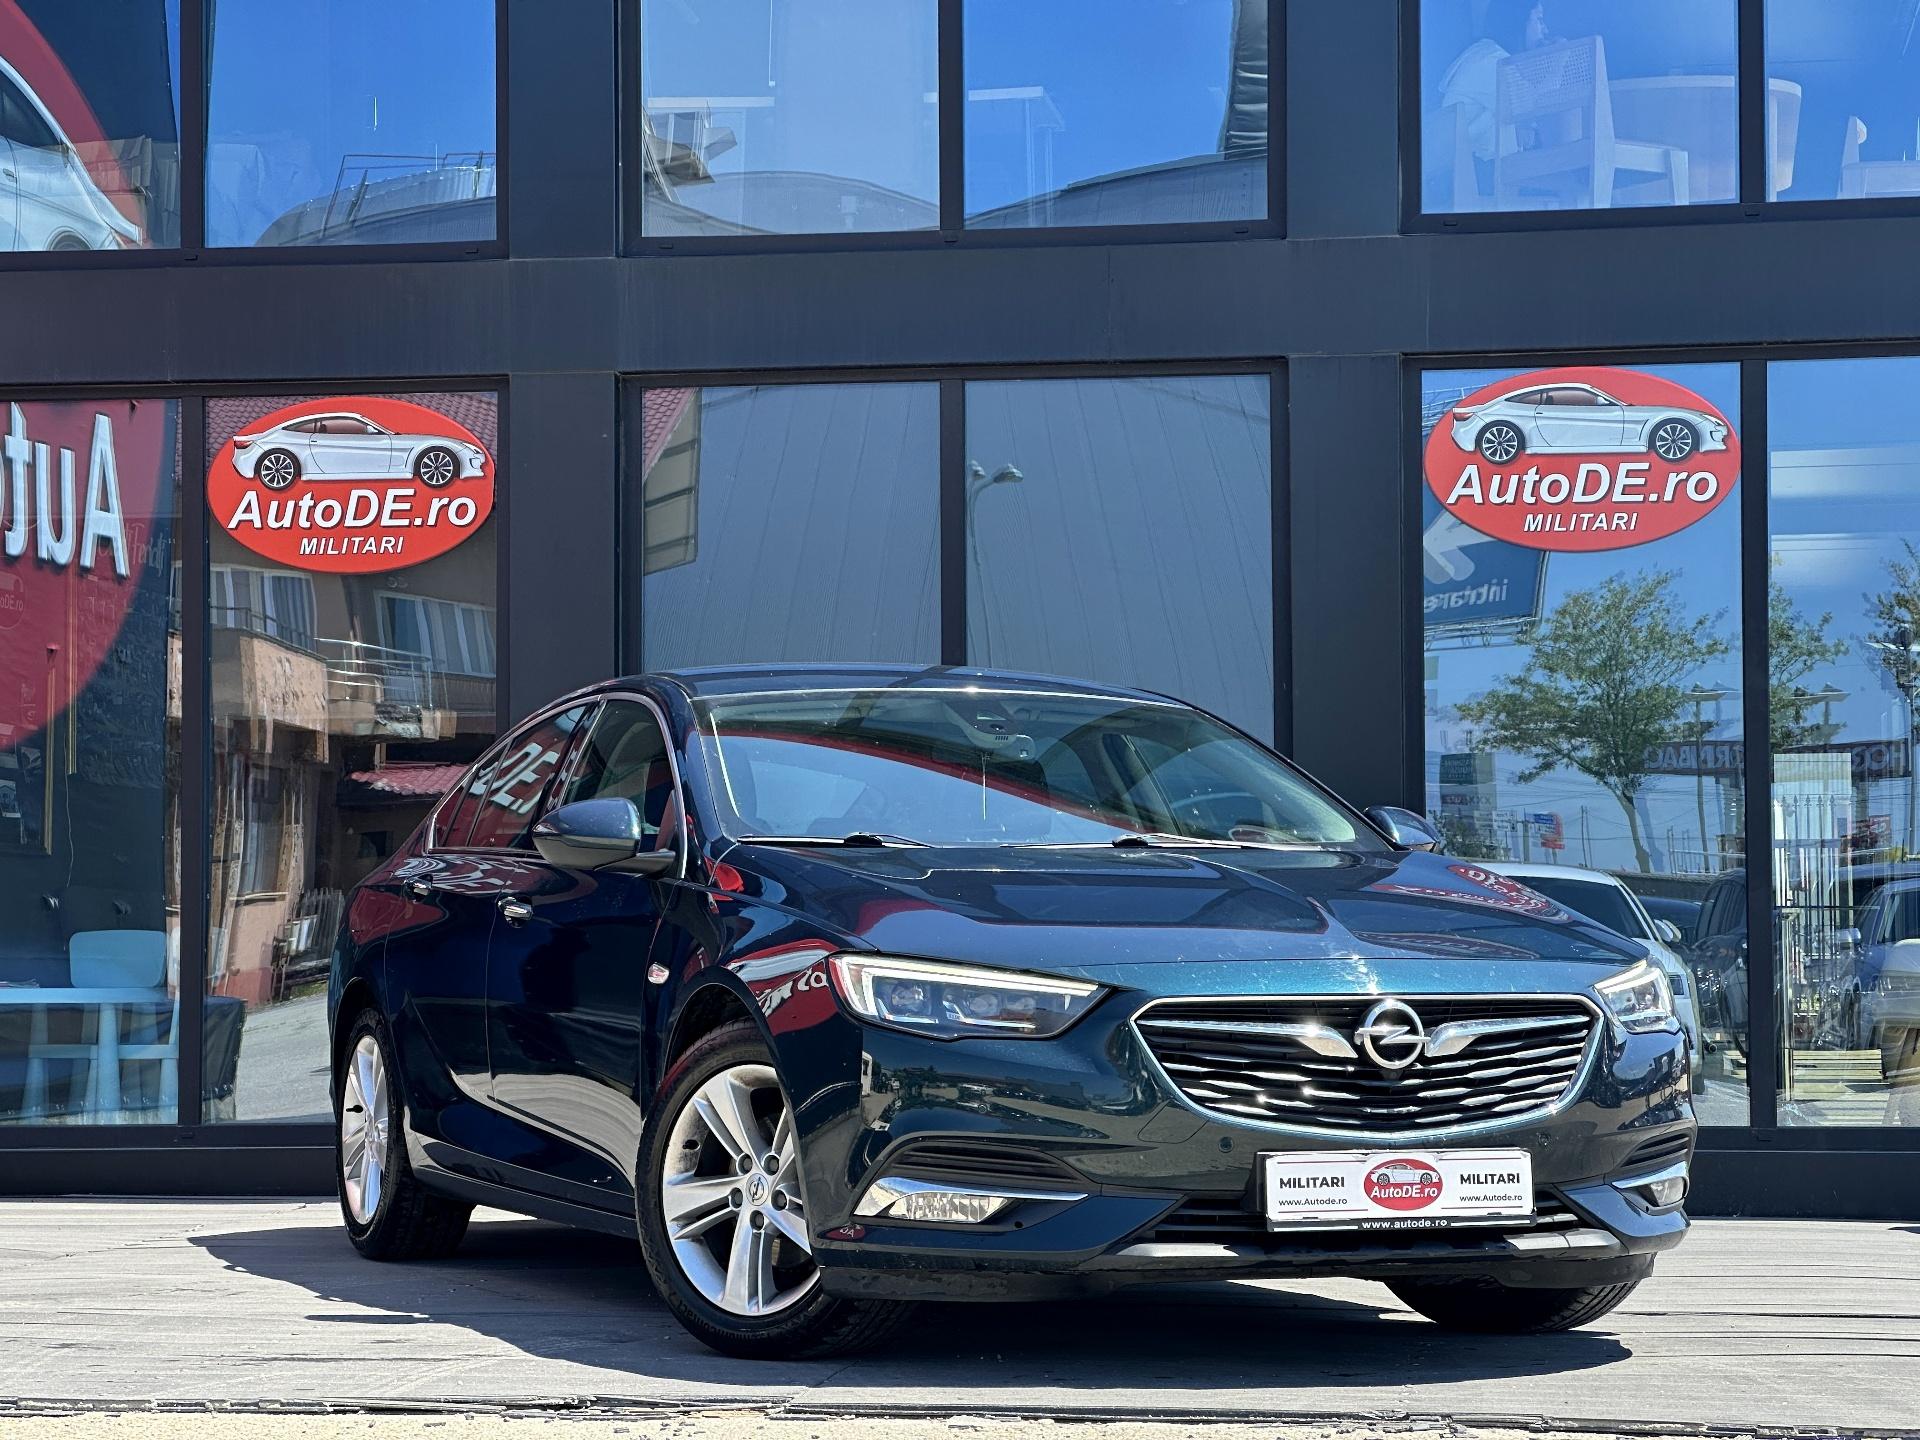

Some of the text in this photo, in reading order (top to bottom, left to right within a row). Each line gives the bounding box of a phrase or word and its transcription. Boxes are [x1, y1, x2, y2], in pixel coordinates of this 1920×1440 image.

[1446, 463, 1718, 504] AutoDE.ro
[228, 489, 476, 529] AutoDE.ro
[1523, 512, 1638, 532] MILITARI
[299, 537, 404, 555] MILITARI
[1279, 1176, 1345, 1188] MILITARI
[1460, 1173, 1520, 1185] MILITARI
[1371, 1186, 1438, 1199] AutoDE.ro
[1459, 1193, 1523, 1202] www.Autode.ro
[1278, 1197, 1348, 1206] www.Autode.ro
[1362, 1218, 1448, 1229] www.autode.ro
